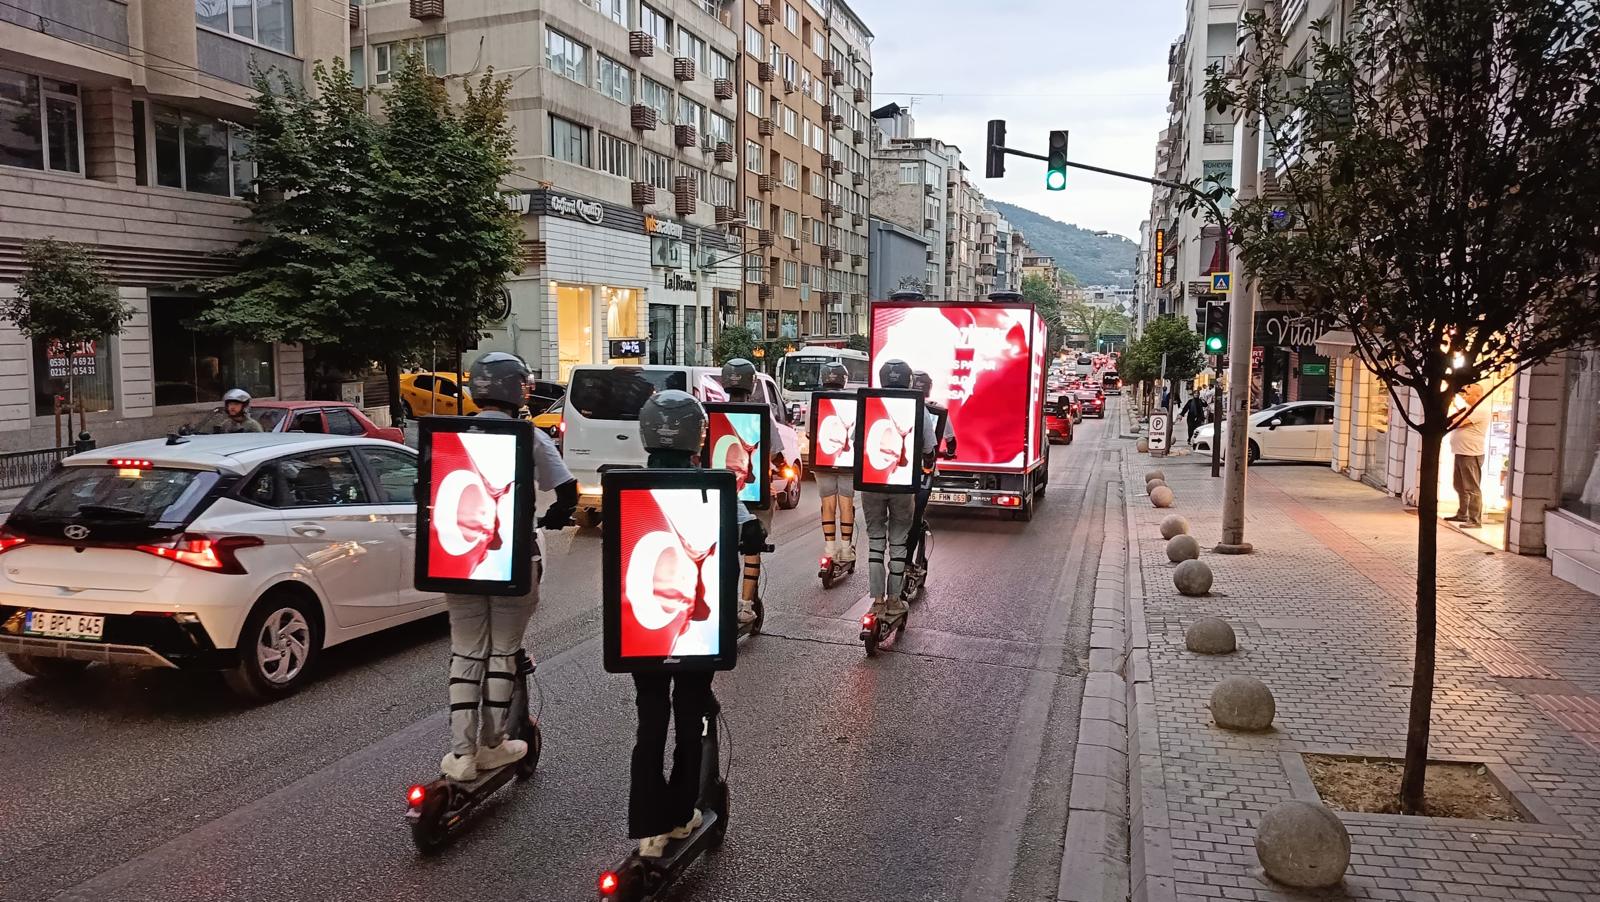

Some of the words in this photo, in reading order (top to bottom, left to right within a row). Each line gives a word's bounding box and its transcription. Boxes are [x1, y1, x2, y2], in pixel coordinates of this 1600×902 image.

[33, 614, 44, 629] 16
[50, 614, 72, 632] BPC
[78, 617, 101, 634] 645
